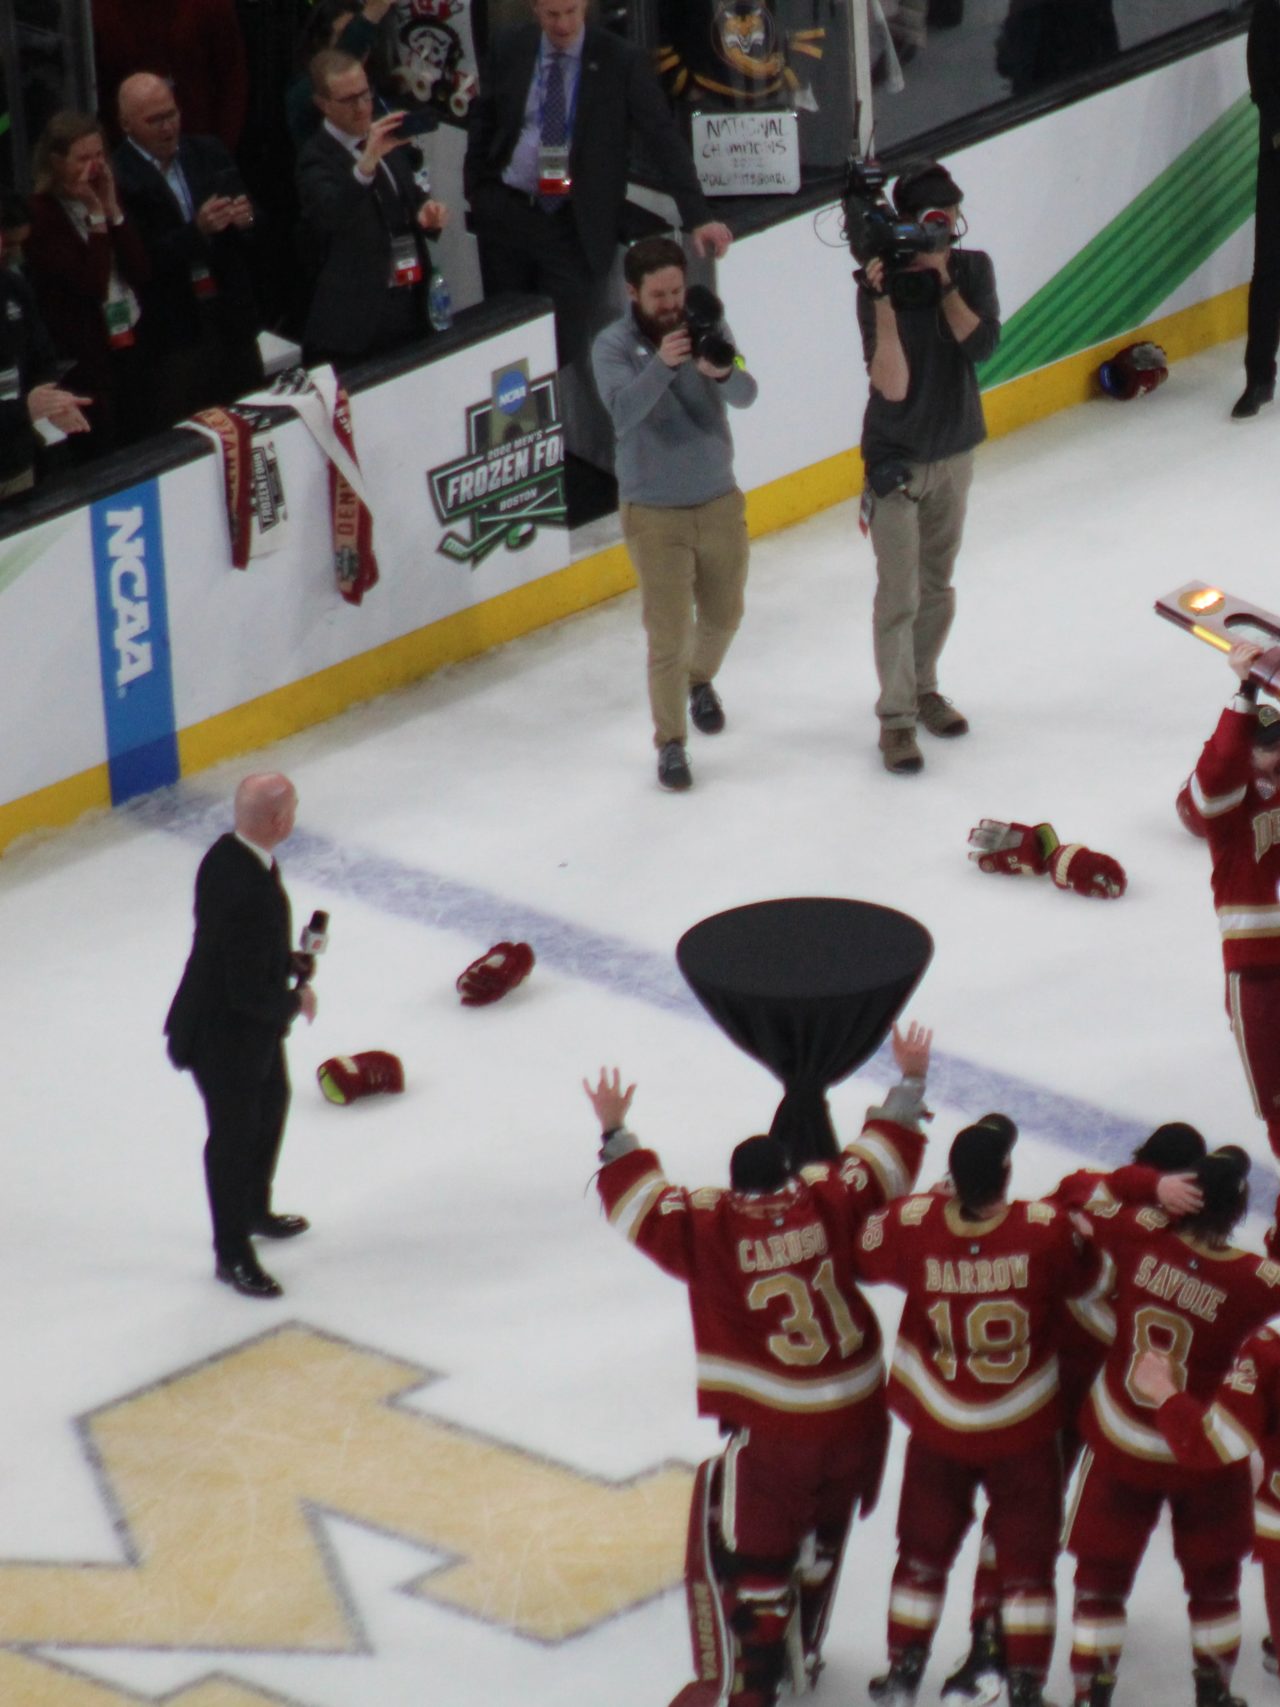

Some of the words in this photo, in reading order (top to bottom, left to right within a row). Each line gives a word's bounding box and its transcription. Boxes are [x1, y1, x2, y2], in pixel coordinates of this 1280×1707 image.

[446, 448, 530, 509] FROZEN
[500, 487, 538, 512] BOSTON
[106, 506, 153, 688] NCAA
[738, 1222, 829, 1273] CARUSO
[925, 1254, 1029, 1294] BARROW
[747, 1258, 865, 1366] 31
[1134, 1255, 1227, 1324] SAVOIE
